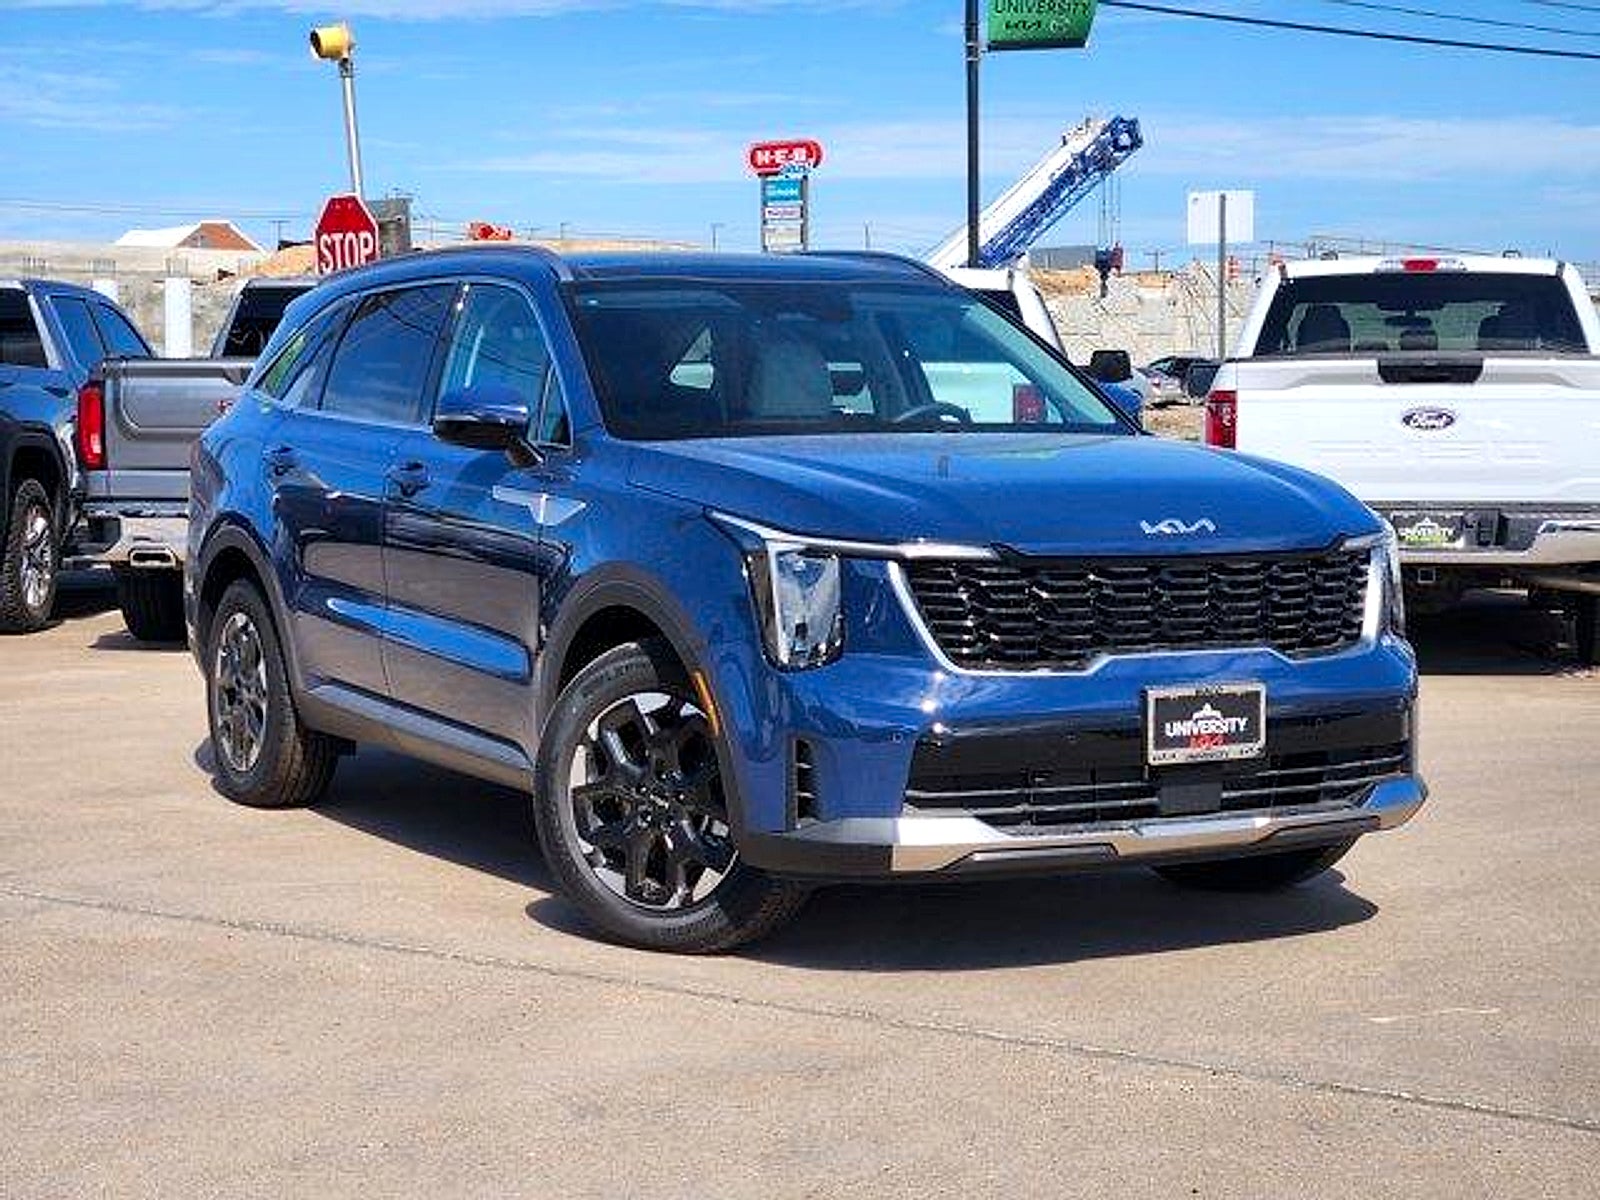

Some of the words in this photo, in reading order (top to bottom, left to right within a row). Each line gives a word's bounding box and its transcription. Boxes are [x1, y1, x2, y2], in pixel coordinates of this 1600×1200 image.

[319, 230, 374, 274] STOP
[1410, 411, 1448, 428] Ford
[1164, 717, 1249, 737] UNIVERSITY
